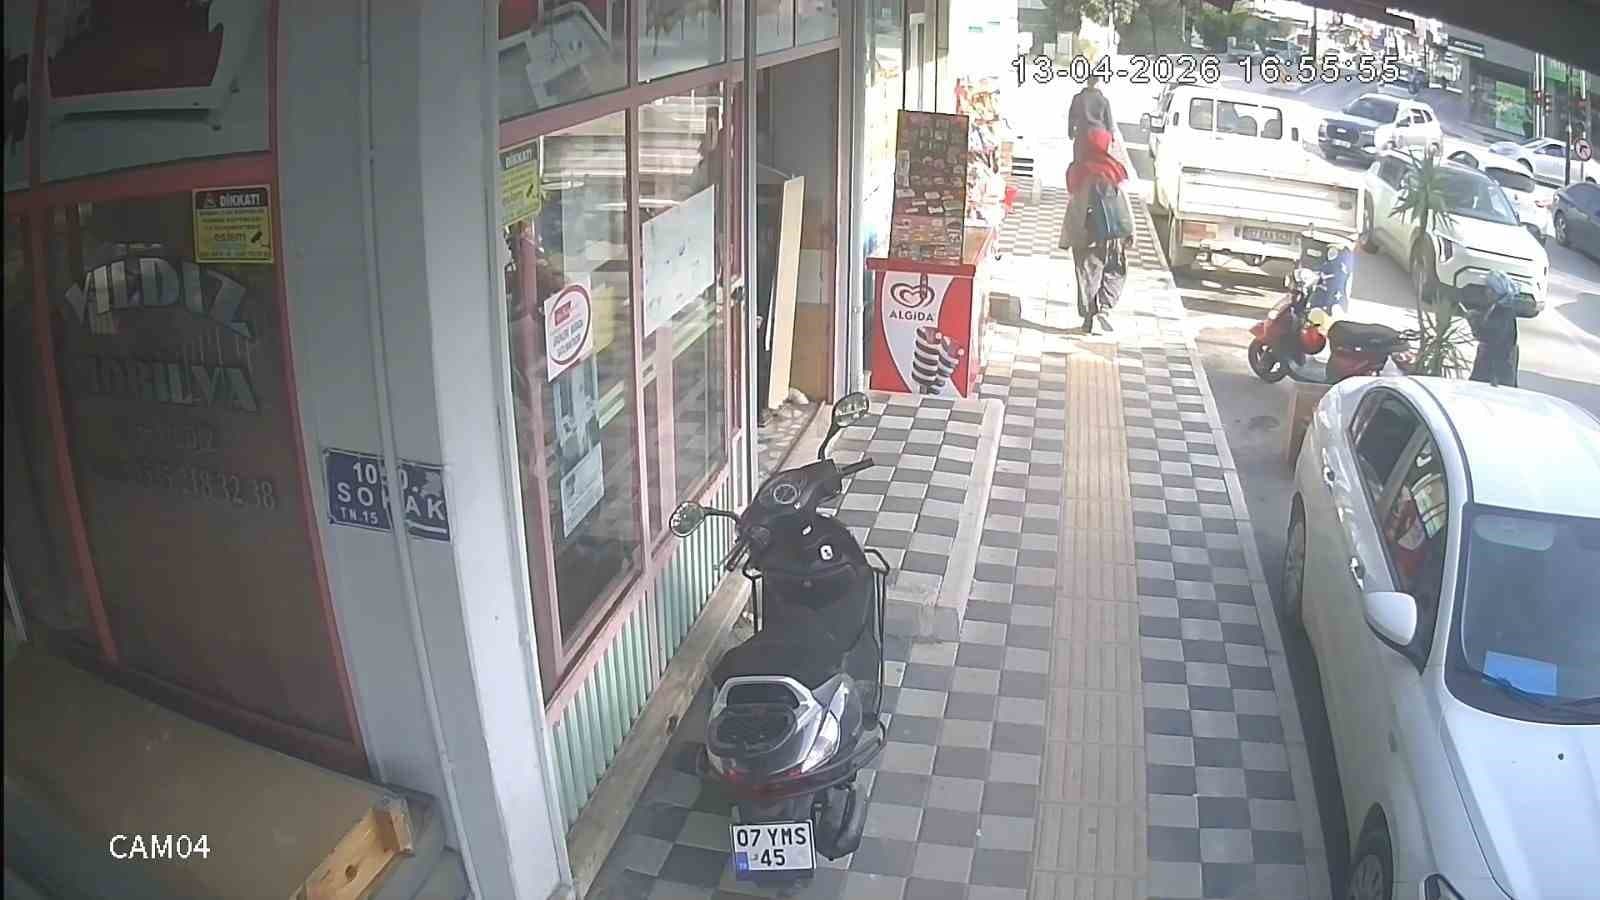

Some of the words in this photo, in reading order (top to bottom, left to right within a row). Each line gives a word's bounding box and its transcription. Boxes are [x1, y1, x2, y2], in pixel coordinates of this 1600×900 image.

[737, 828, 761, 847] 07
[768, 827, 807, 846] YMS
[760, 848, 786, 867] 45
